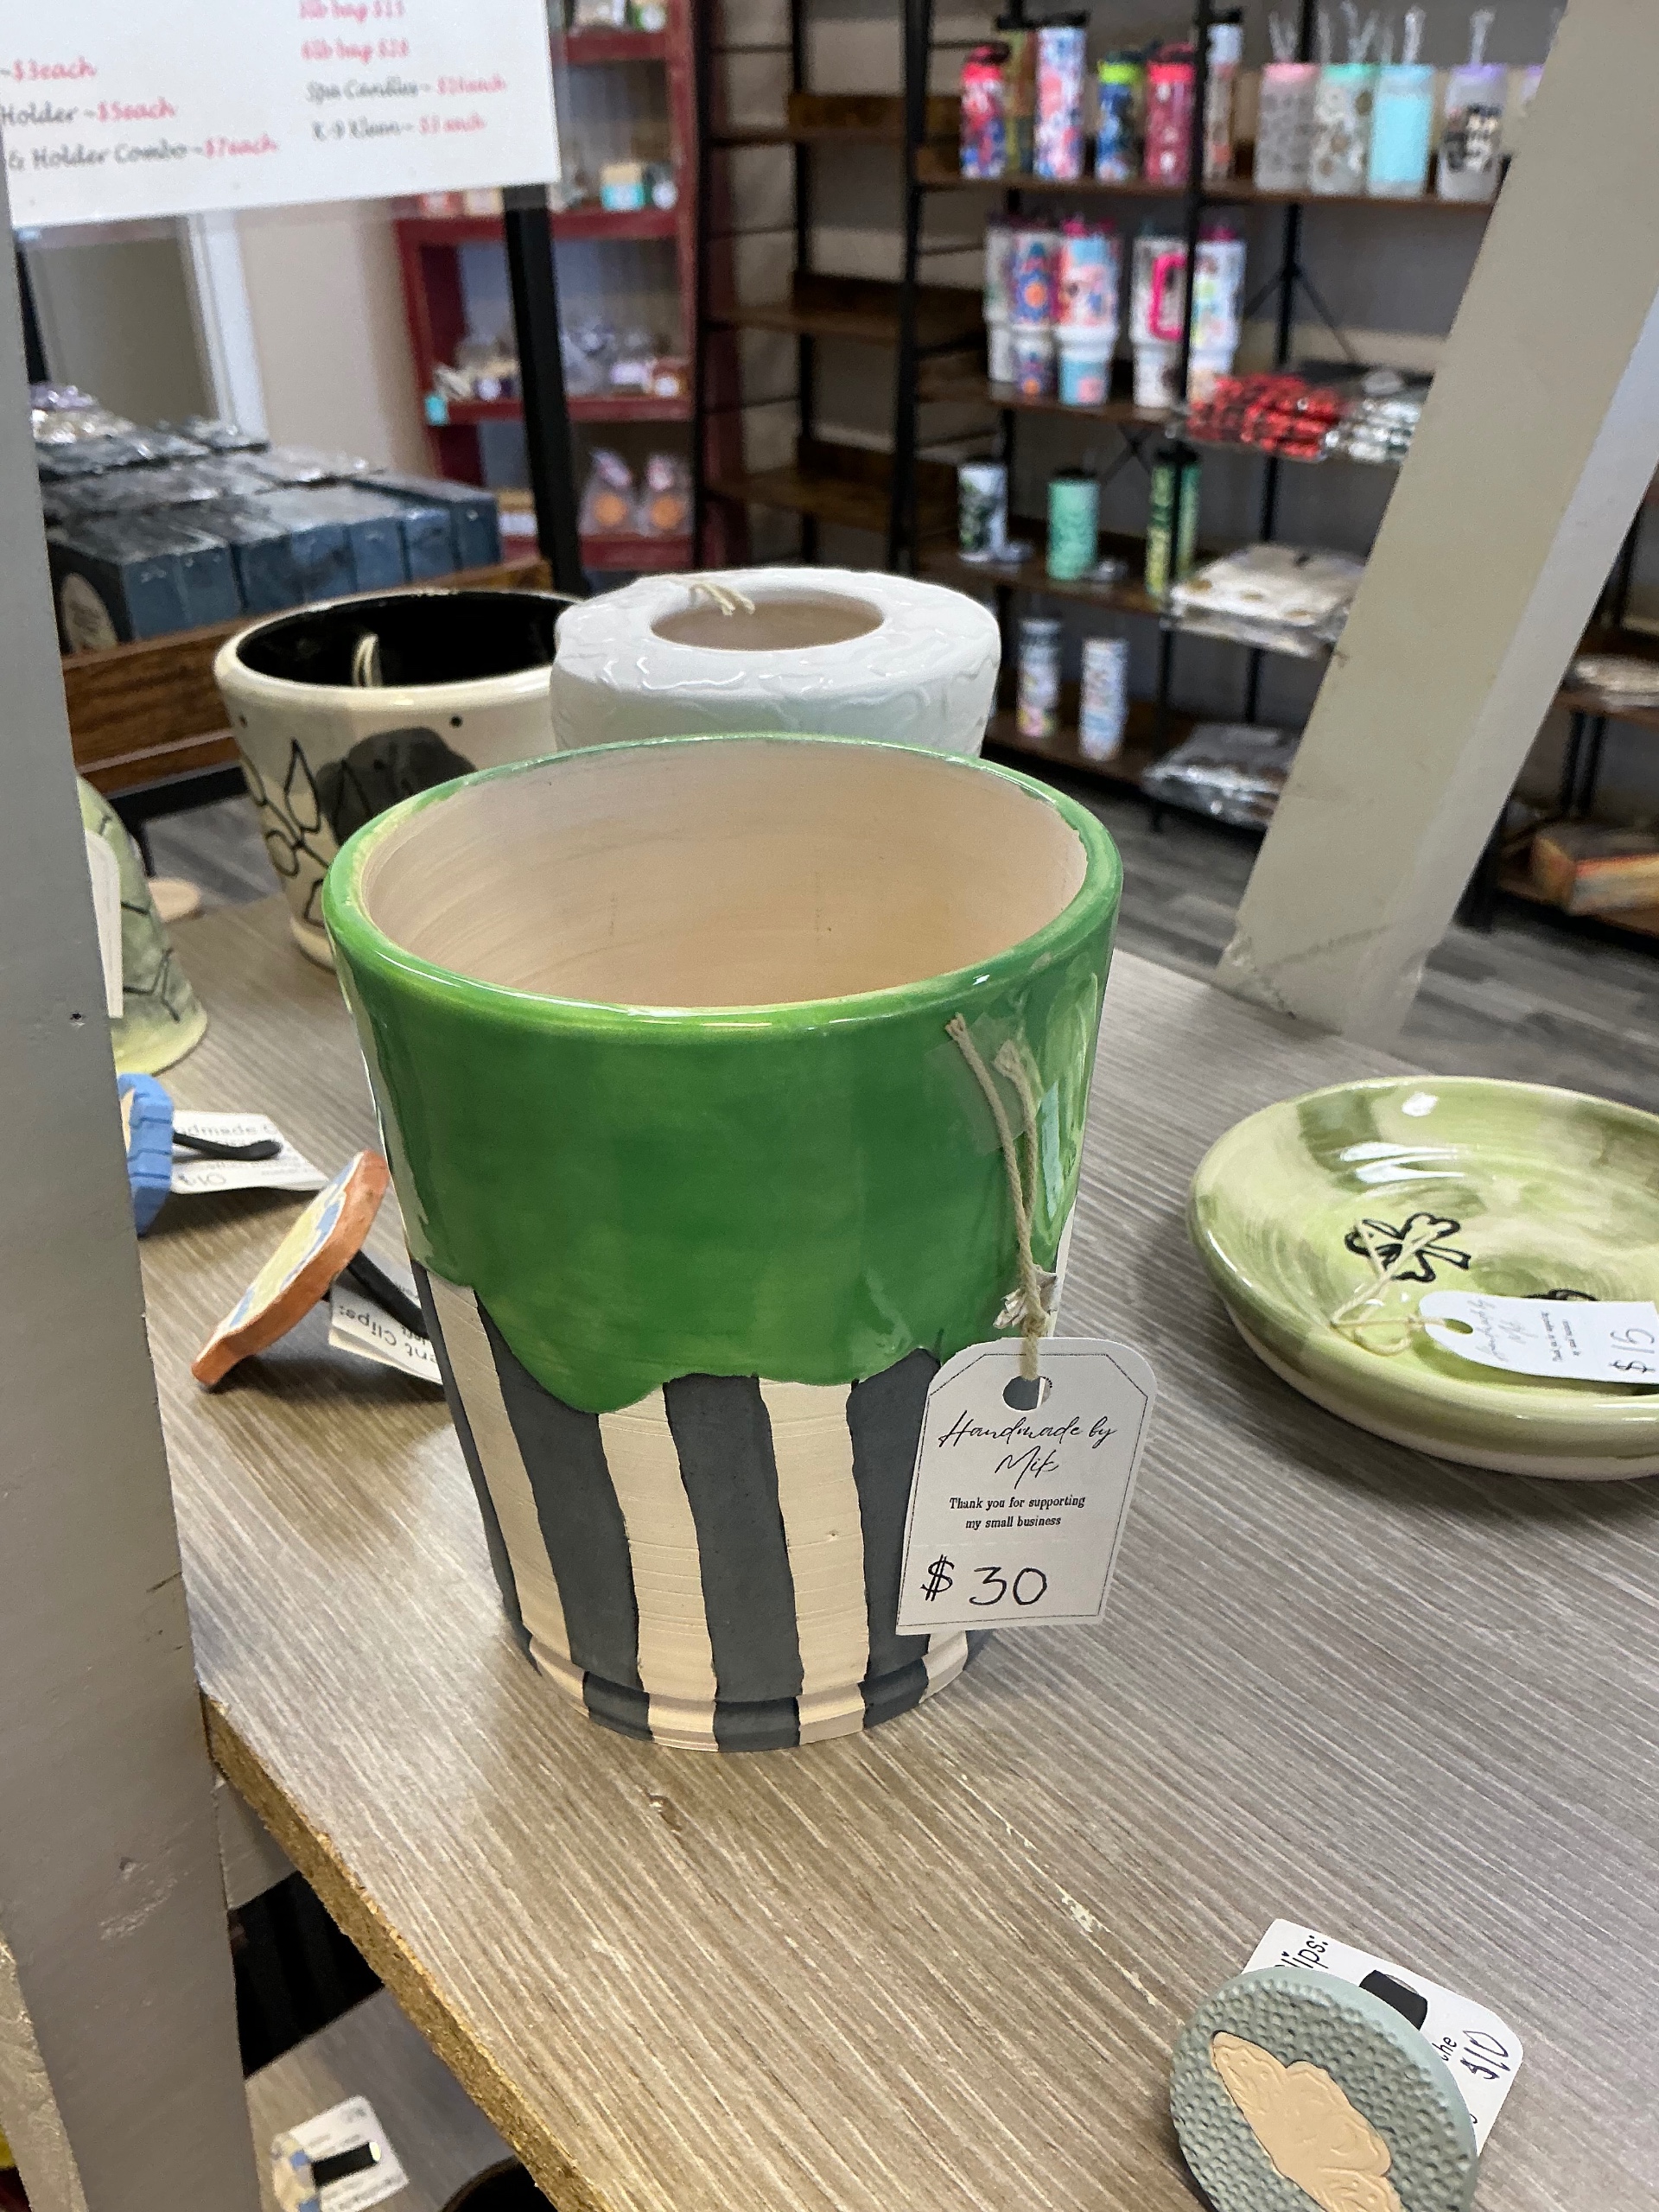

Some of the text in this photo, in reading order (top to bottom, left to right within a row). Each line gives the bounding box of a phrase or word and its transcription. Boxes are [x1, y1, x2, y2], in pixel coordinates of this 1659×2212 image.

[32, 143, 109, 169] Holder
[404, 1343, 437, 1363] ent
[938, 1410, 1117, 1448] Handmade by
[950, 1494, 1086, 1511] Thank you for supporting
[966, 1515, 1062, 1530] my small business
[1274, 1935, 1329, 1969] lips:
